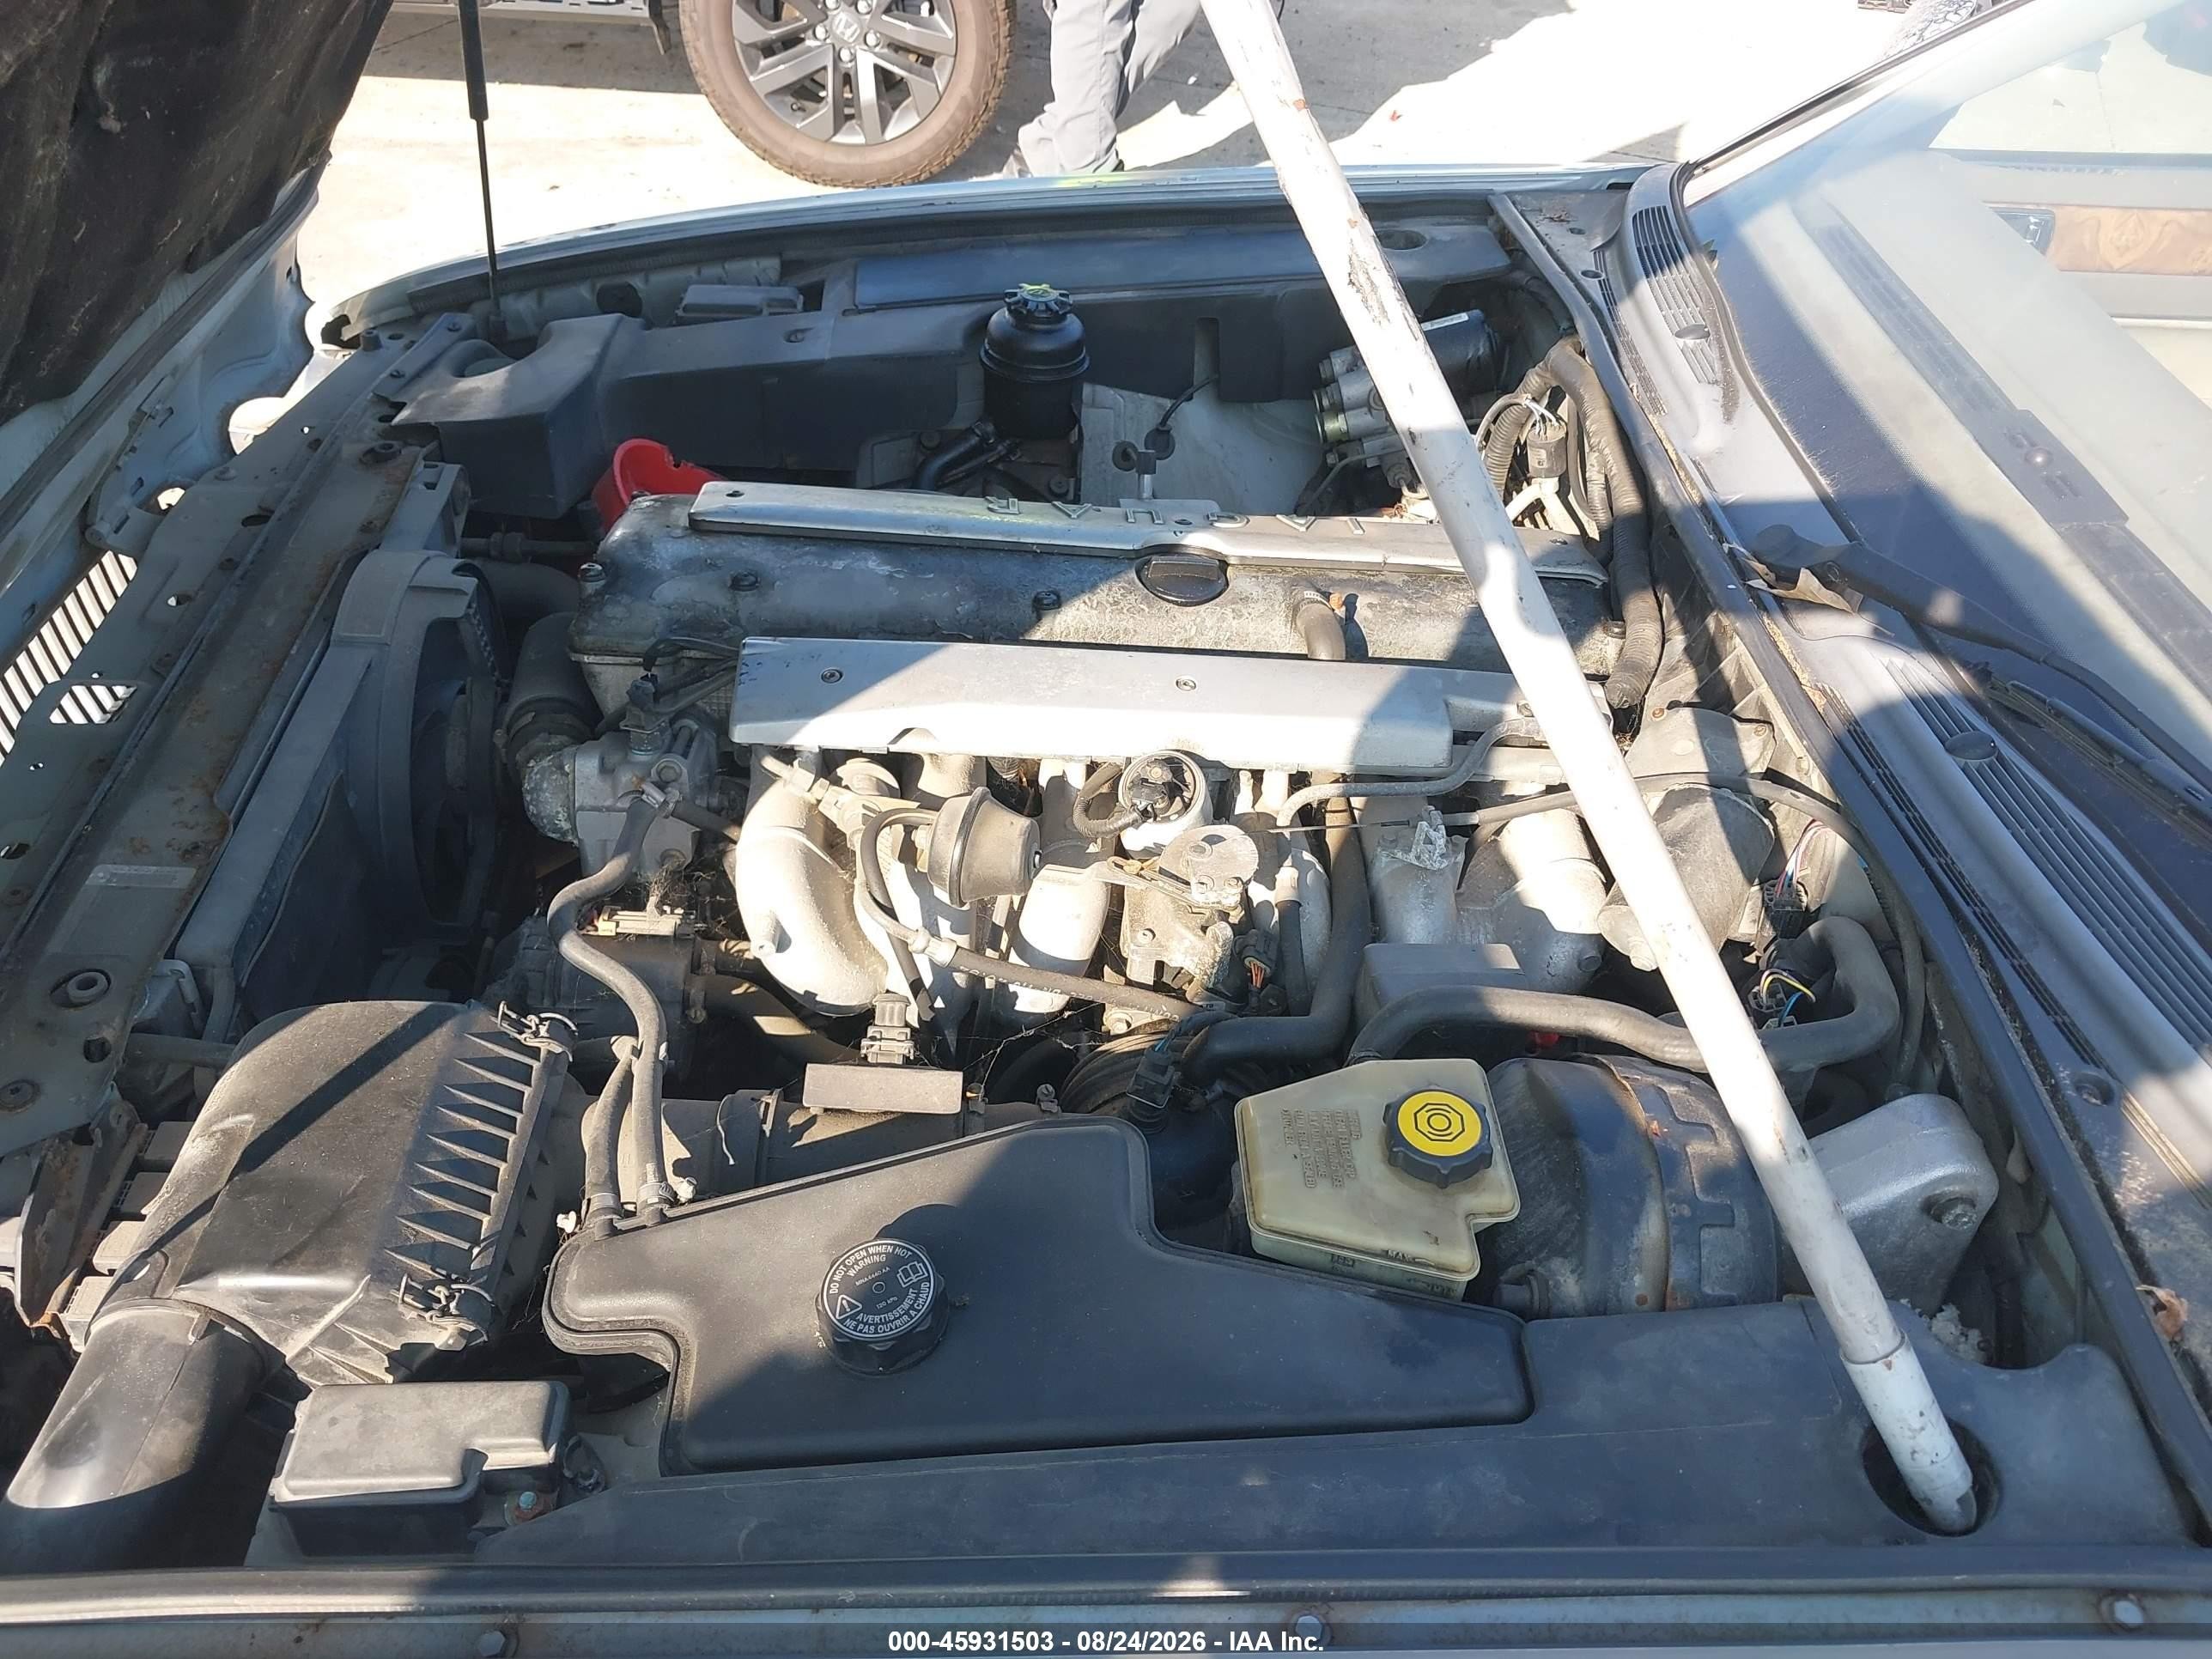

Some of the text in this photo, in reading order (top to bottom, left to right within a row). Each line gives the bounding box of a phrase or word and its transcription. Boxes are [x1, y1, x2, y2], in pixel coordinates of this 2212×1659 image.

[830, 1245, 912, 1294] DO NOT OPEN WHEN HOT
[847, 1255, 886, 1277] WARNING
[843, 1319, 856, 1329] NE
[857, 1324, 875, 1334] PAS
[878, 1316, 910, 1333] OUVRIR
[914, 1282, 929, 1310] CHAUD
[856, 1288, 918, 1323] AVERTISSEMENT
